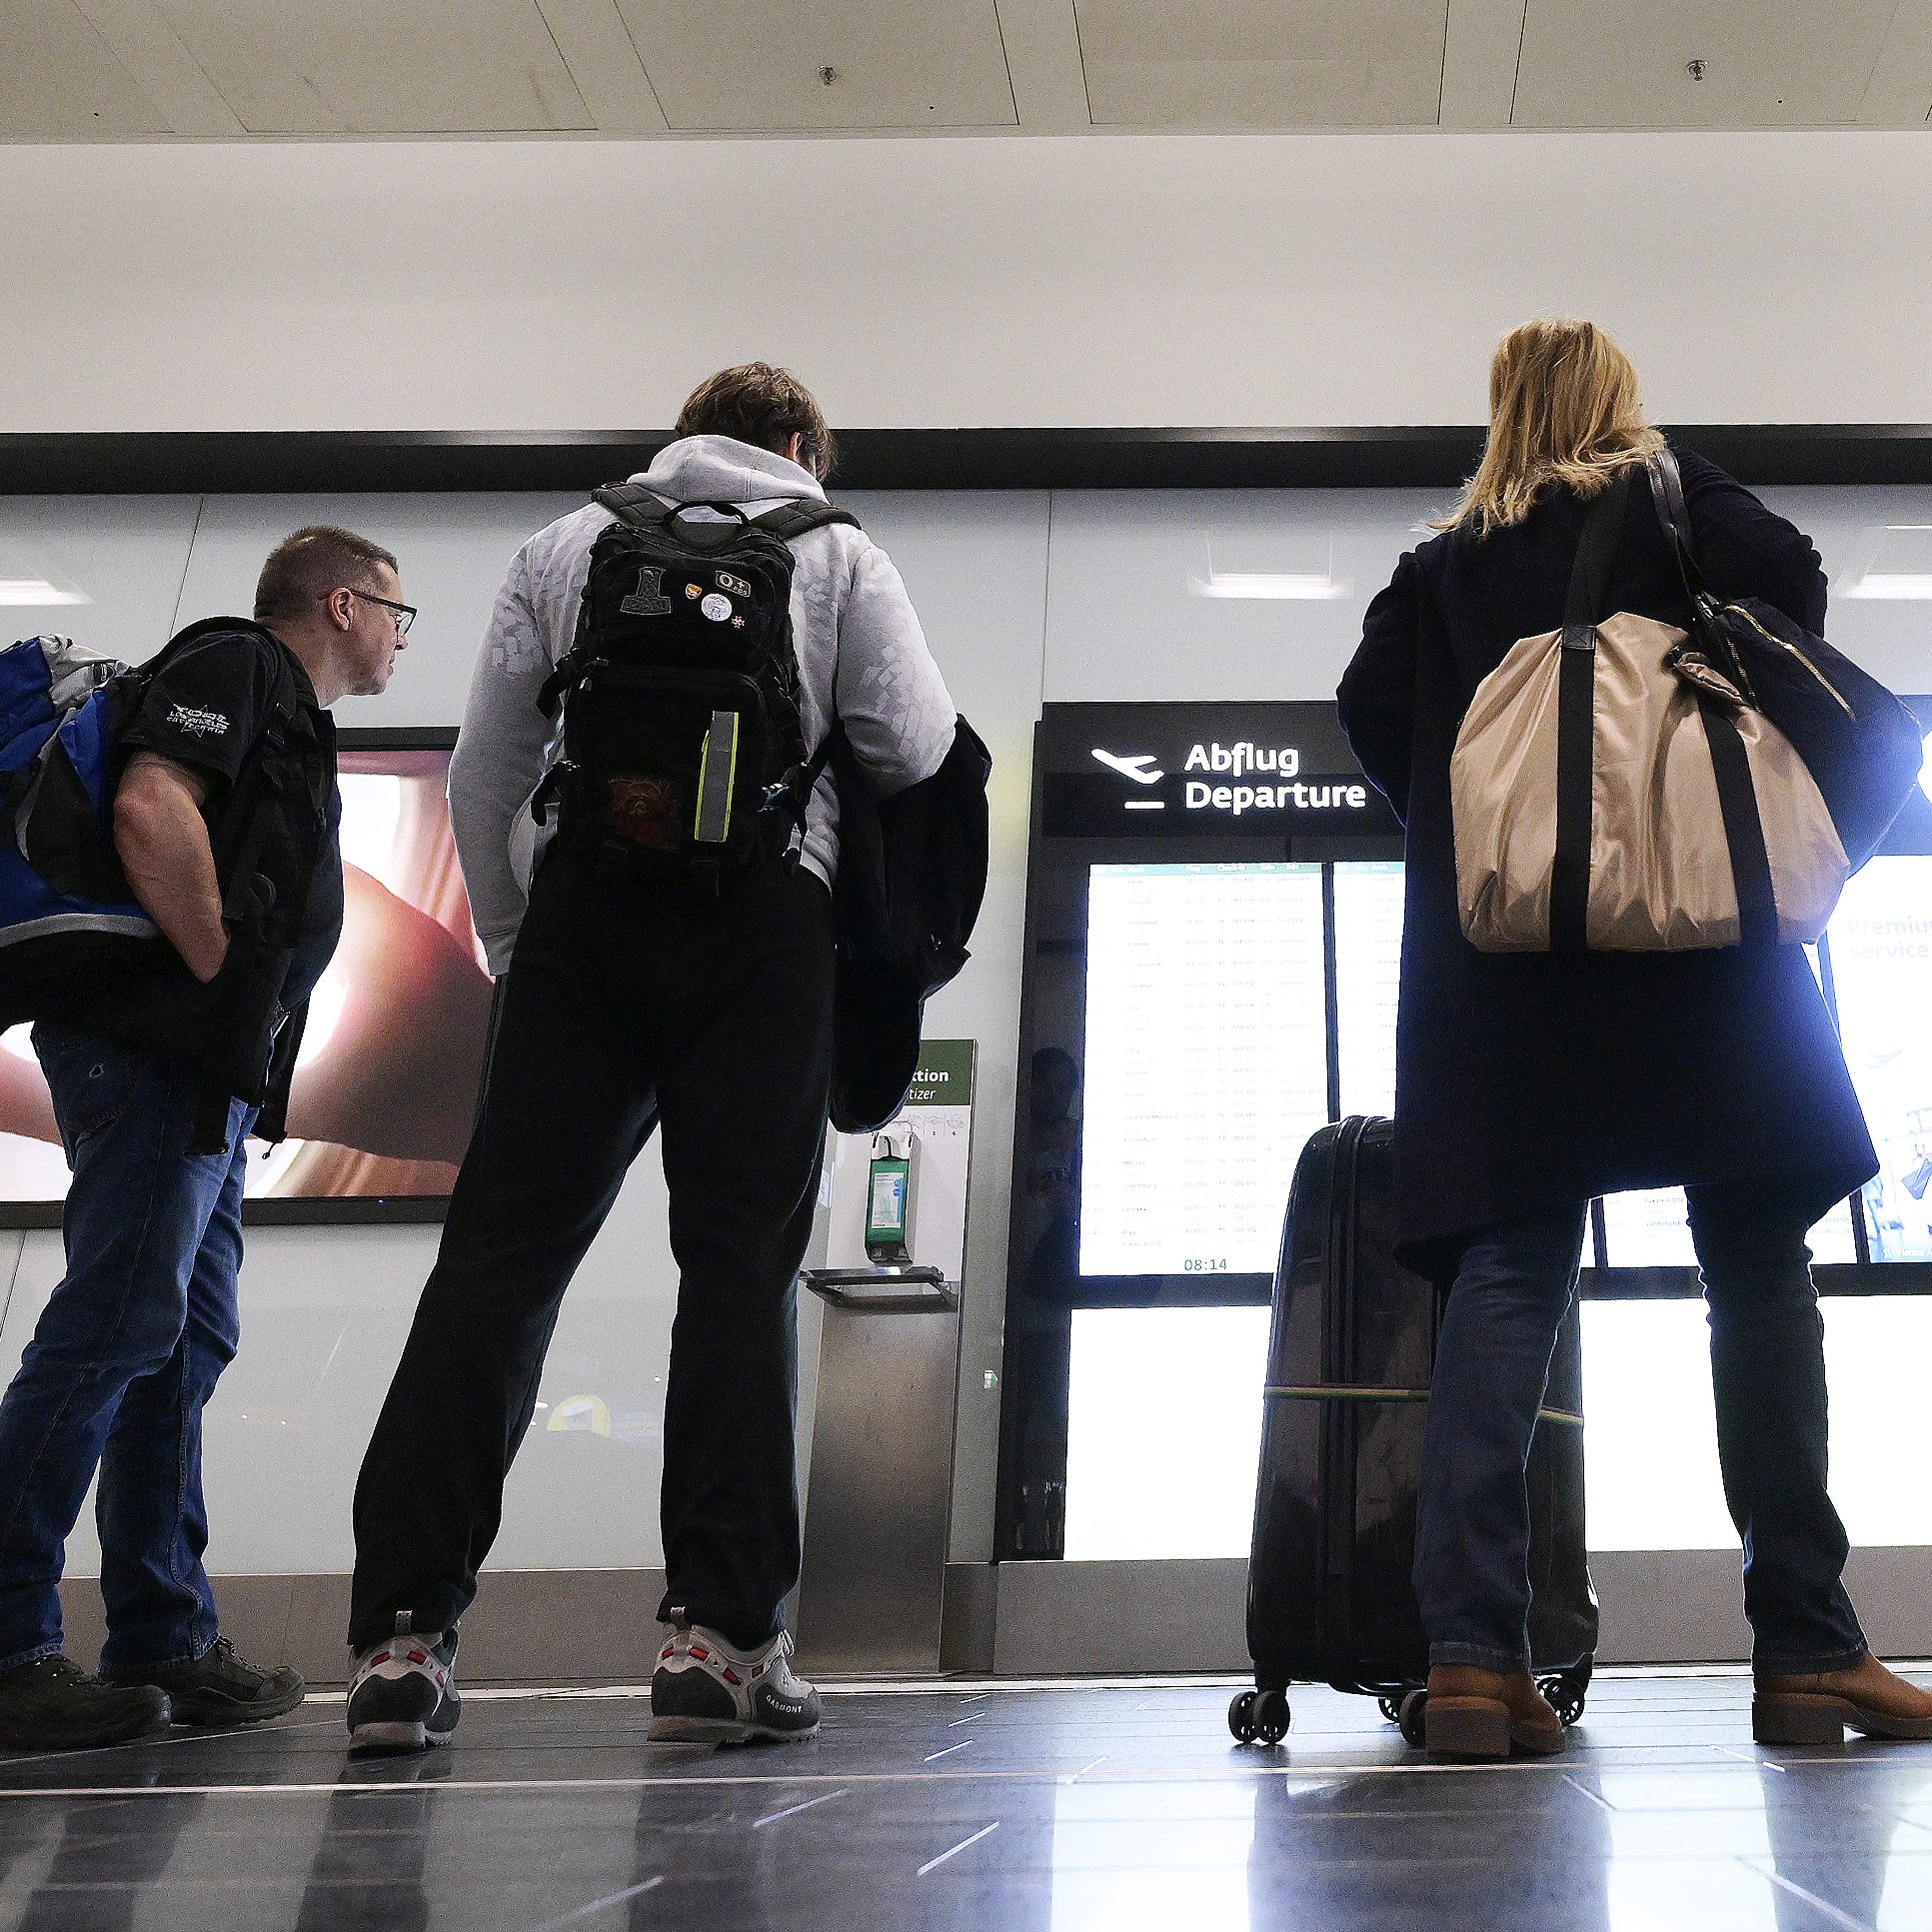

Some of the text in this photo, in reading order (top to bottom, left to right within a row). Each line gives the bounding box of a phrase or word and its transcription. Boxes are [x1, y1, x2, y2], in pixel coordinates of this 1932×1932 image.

[1183, 742, 1300, 778] Abflug
[1184, 782, 1367, 817] Departure
[1847, 913, 1932, 935] Premiu
[1850, 939, 1930, 959] service
[1183, 1257, 1228, 1271] 08:14
[765, 1694, 804, 1715] GARMONT
